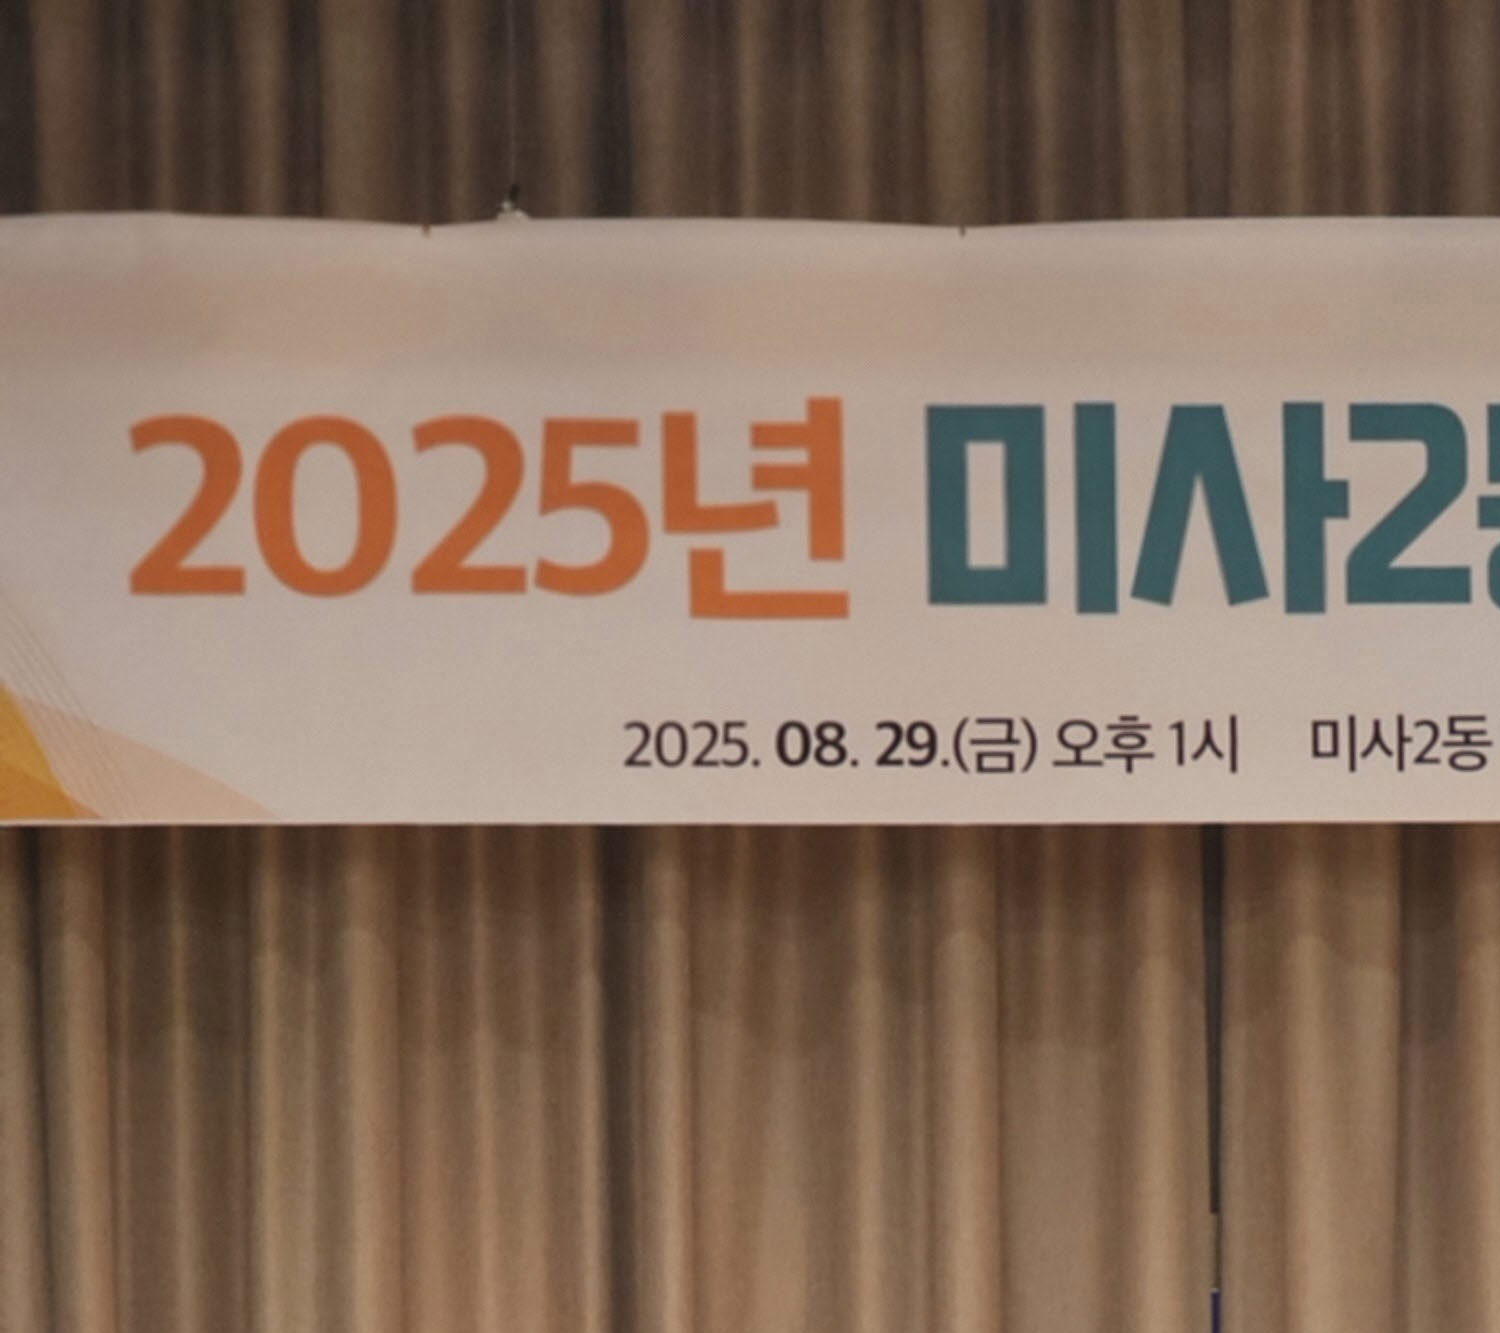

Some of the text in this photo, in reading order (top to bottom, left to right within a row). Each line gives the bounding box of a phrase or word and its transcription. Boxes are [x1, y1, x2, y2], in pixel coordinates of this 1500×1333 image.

[127, 393, 852, 621] 2025년
[622, 720, 762, 768] 2025.
[775, 719, 860, 768] 08.
[874, 716, 1038, 774] 29.(금)
[1051, 715, 1155, 774] 오후
[1169, 714, 1239, 774] 1시
[1310, 713, 1493, 773] 미사2동
